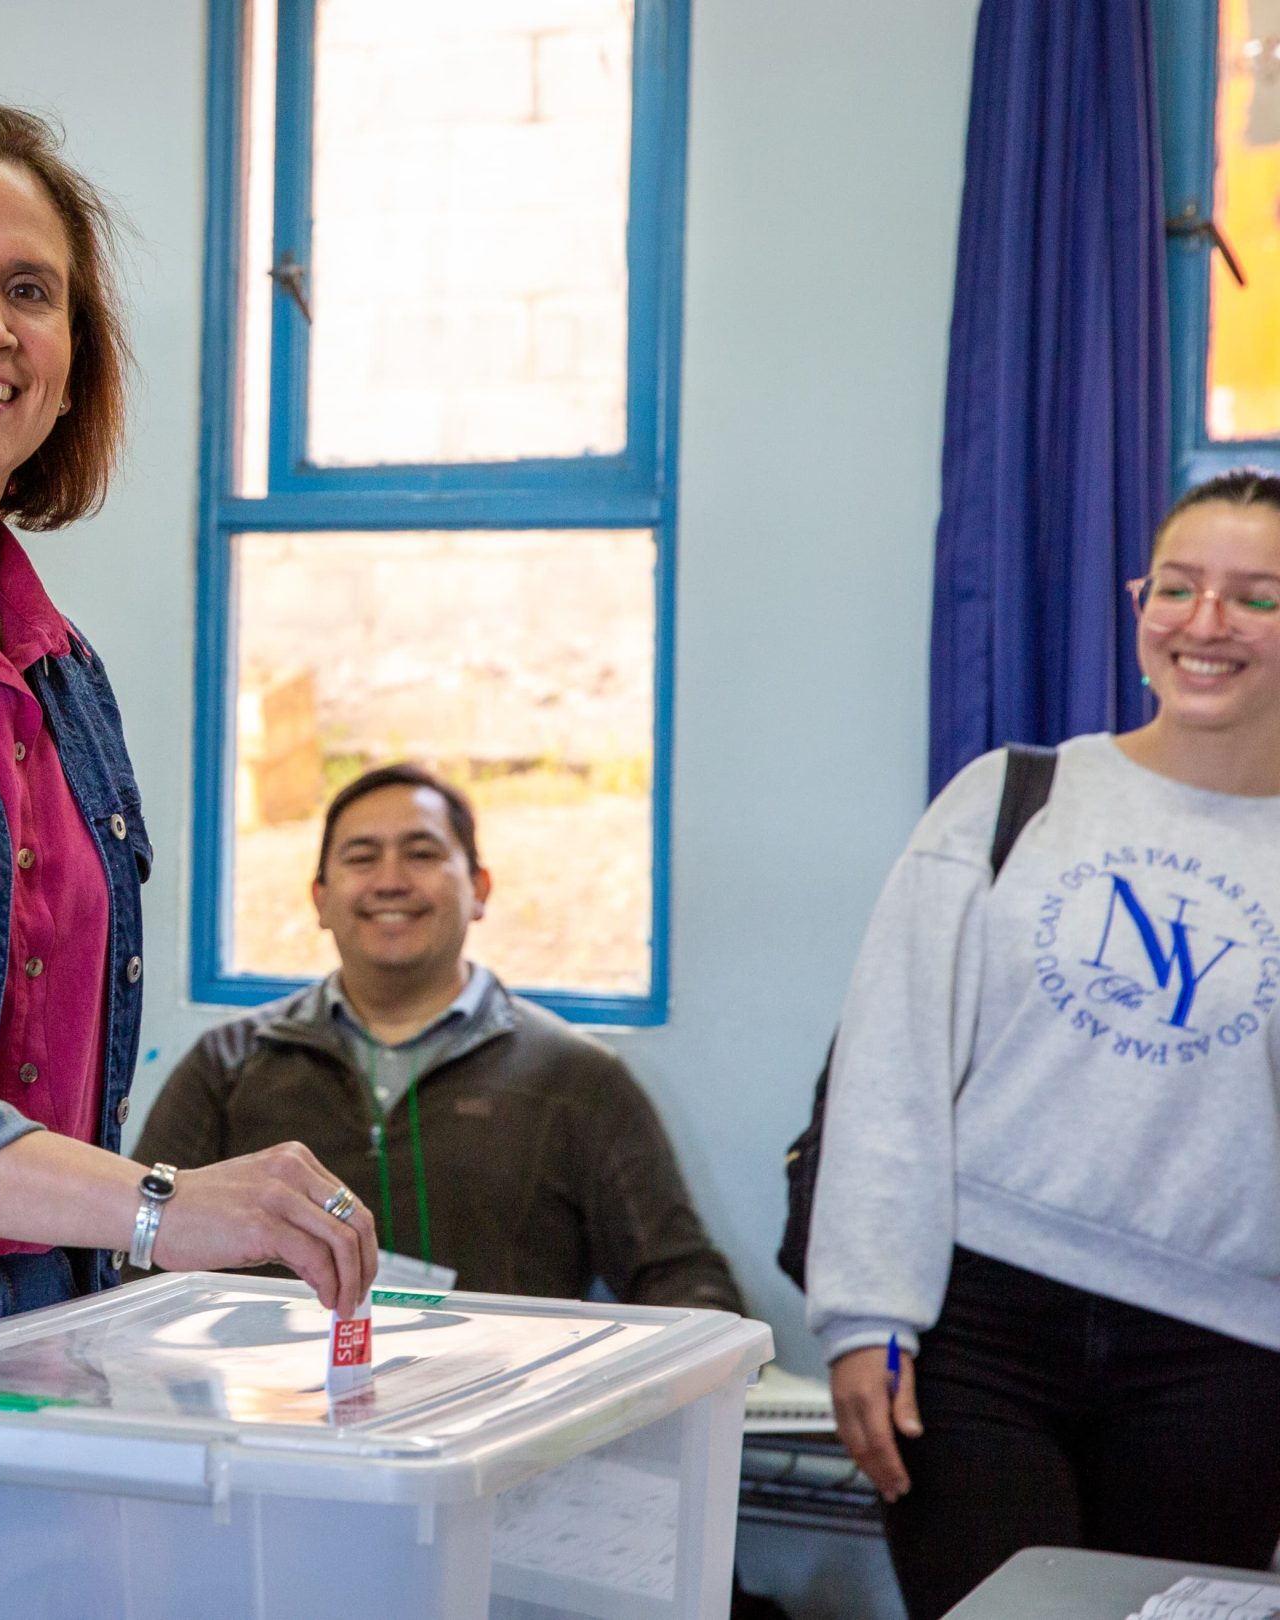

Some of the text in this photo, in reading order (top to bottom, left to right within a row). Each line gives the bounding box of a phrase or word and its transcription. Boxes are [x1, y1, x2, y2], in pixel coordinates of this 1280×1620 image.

[1103, 846, 1137, 867] AS
[1145, 847, 1201, 876] FAR
[1060, 862, 1096, 890] GO
[1205, 873, 1245, 900] AS
[1034, 893, 1064, 948] CAN
[1080, 871, 1248, 1033] NY
[1035, 955, 1075, 1012] YOU
[1072, 1009, 1111, 1039] AS
[1218, 1012, 1260, 1046] GO
[1113, 1032, 1167, 1065] FAR
[1177, 1035, 1210, 1063] AS
[337, 1323, 353, 1362] SER
